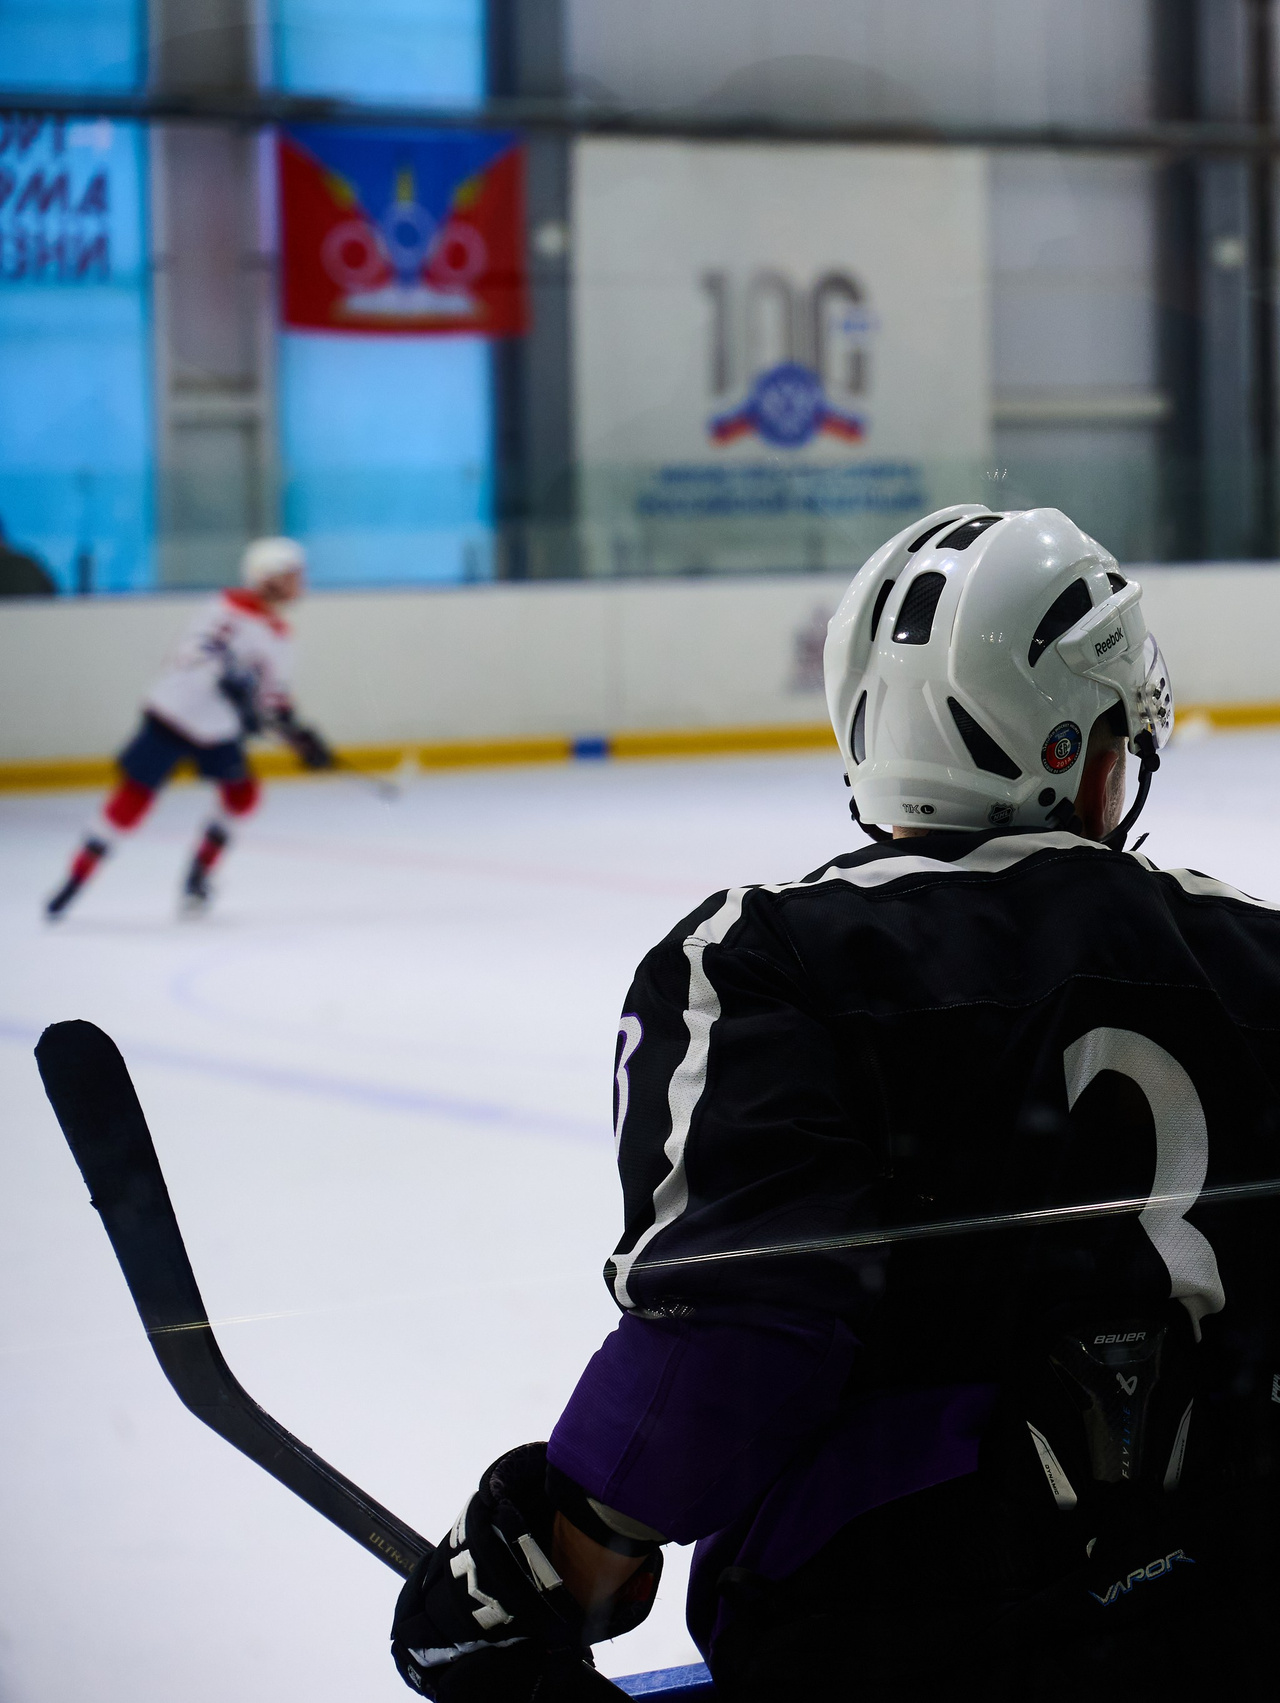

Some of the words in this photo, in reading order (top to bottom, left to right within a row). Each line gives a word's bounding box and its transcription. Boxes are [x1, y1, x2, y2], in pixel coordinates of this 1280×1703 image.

[1094, 627, 1124, 657] Reebok
[1044, 1463, 1060, 1496] DYNAMIC
[1088, 1549, 1196, 1607] VAPOR
